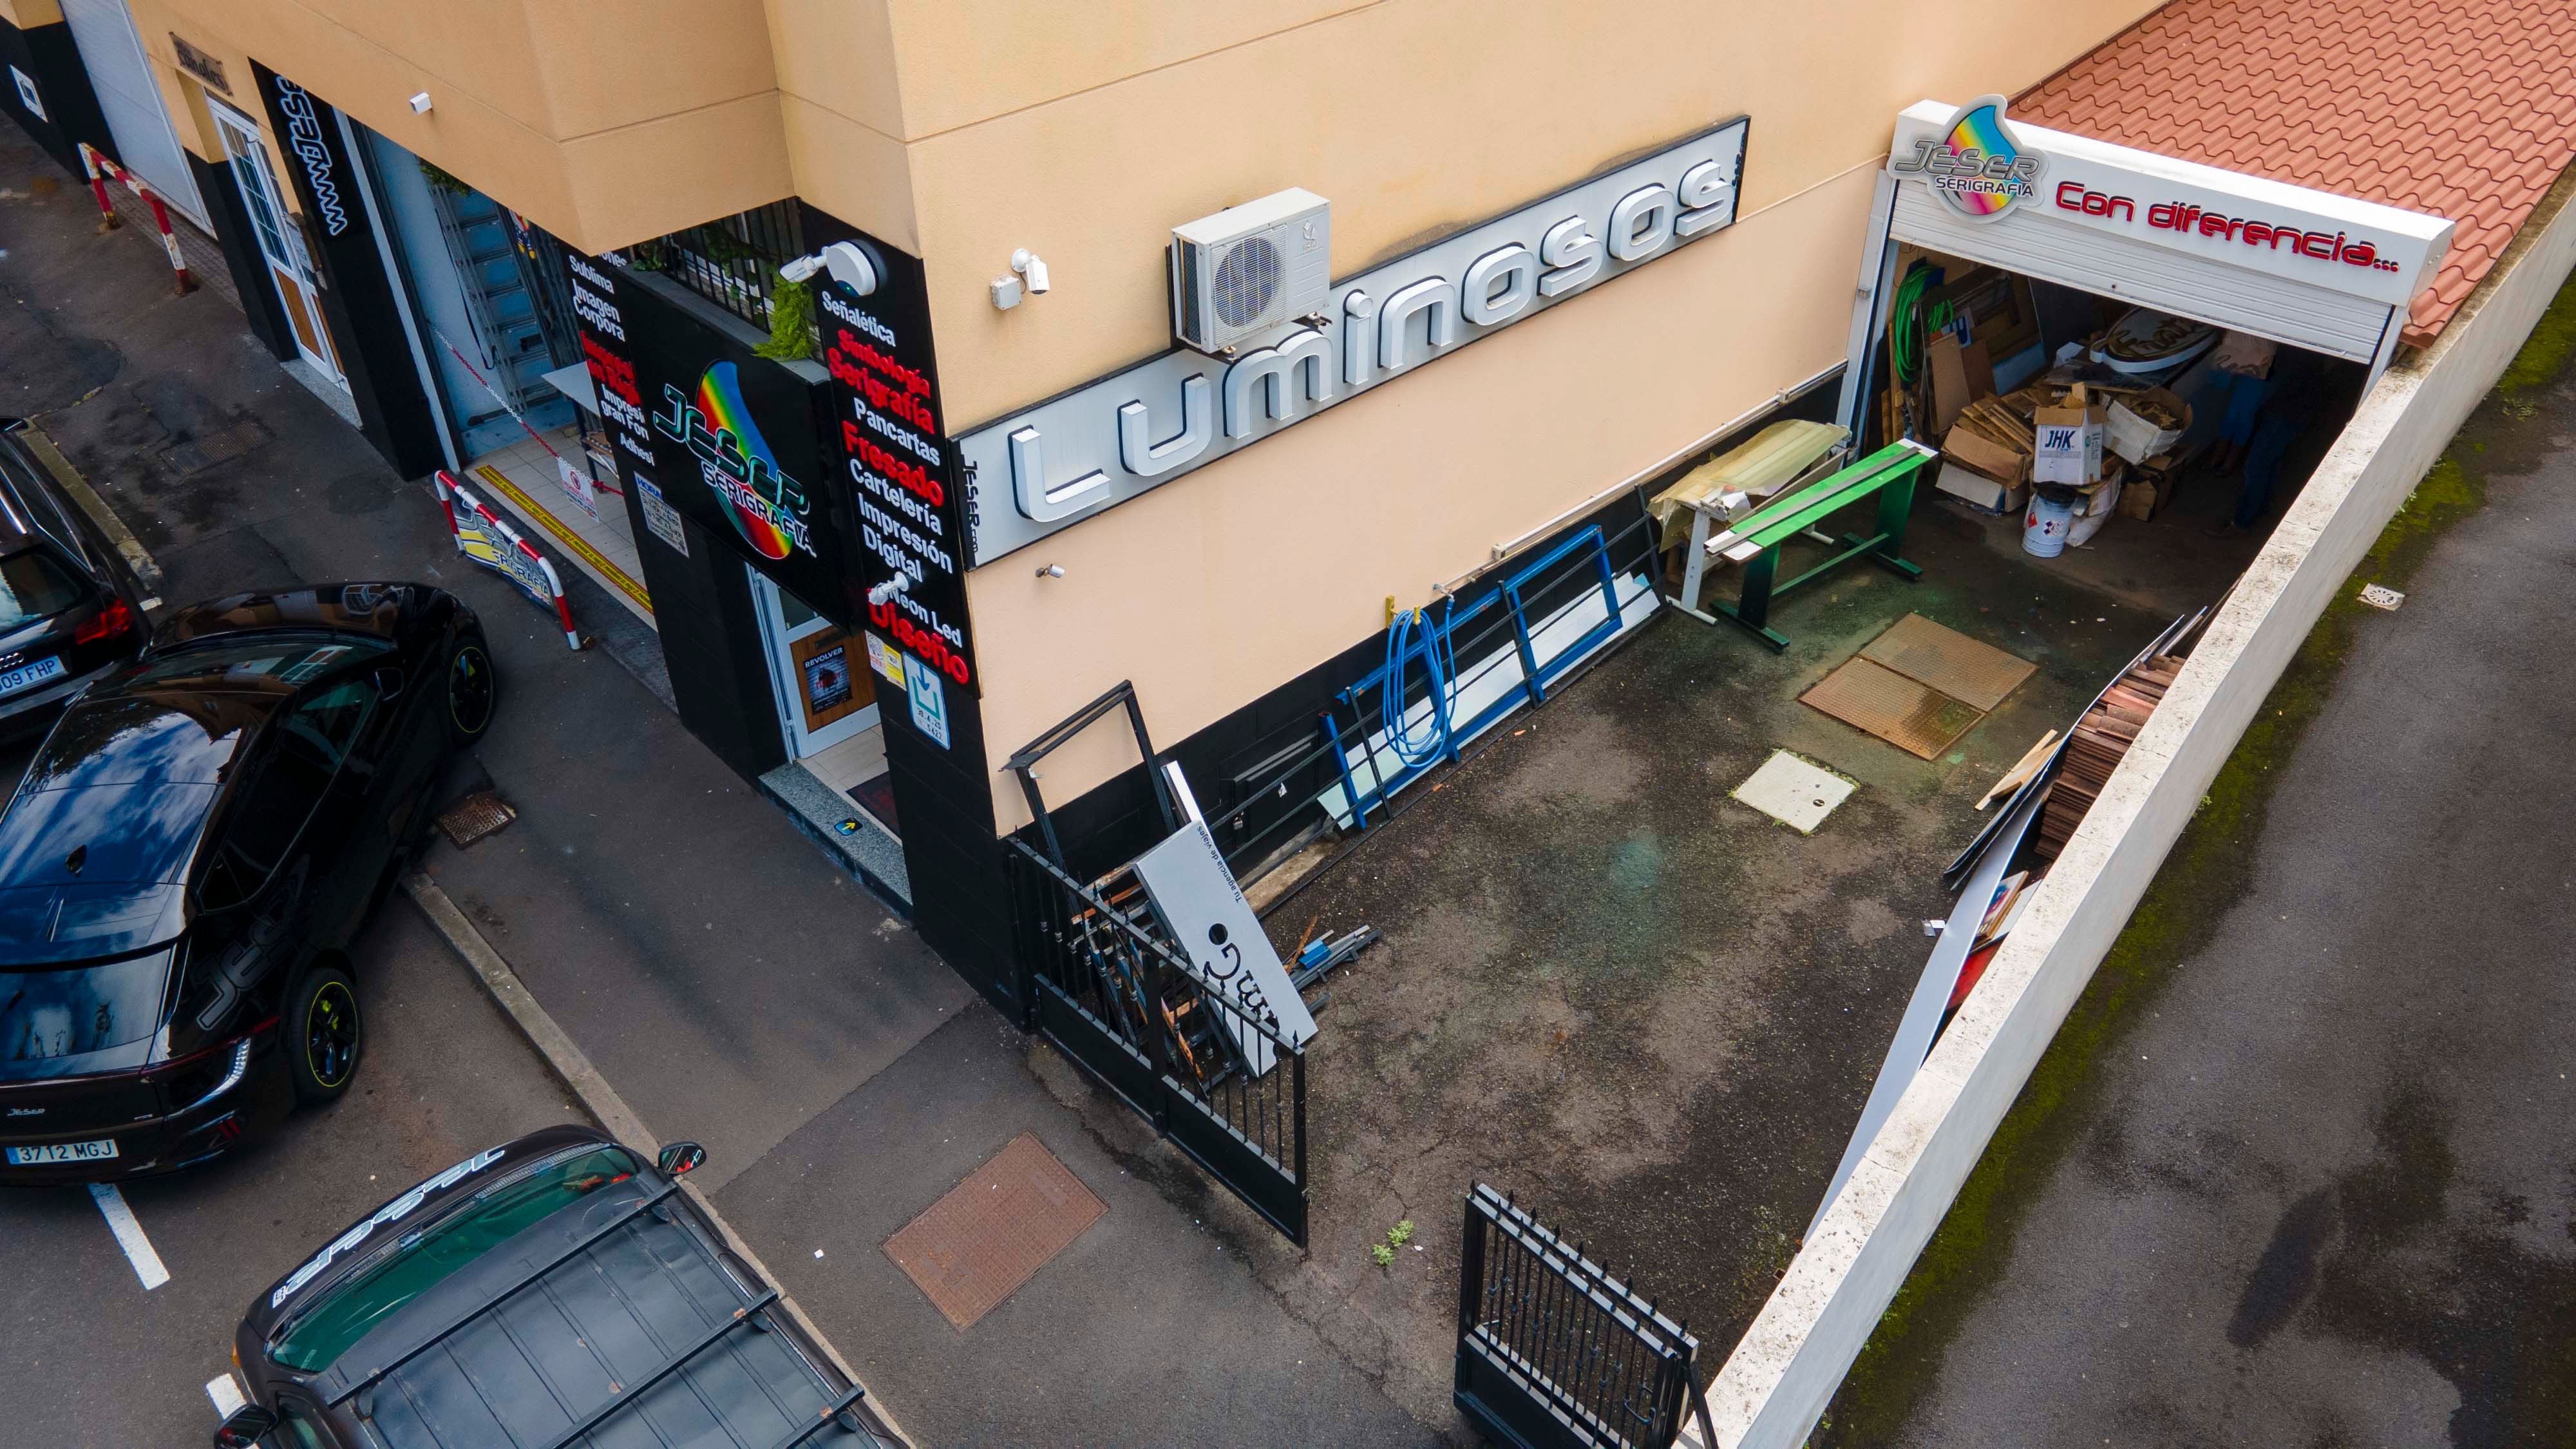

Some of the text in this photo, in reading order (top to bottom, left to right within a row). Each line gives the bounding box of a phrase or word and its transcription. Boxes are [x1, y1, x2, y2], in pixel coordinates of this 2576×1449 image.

[1893, 139, 2040, 183] JESER
[1935, 175, 2034, 198] SERIGRAFIA
[2055, 180, 2400, 274] Con diferencia...
[572, 278, 621, 323] Imagen
[822, 290, 896, 348] Señalética
[838, 327, 931, 401] Simbología
[1011, 158, 1734, 523] Luminosos
[601, 383, 645, 424] Impresi
[827, 346, 935, 435] Serigrafía
[652, 383, 811, 516] JESER
[854, 396, 940, 468] Pancartas
[2045, 430, 2076, 449] JHK
[842, 420, 944, 507] Fresado
[701, 460, 817, 558] SERIGRAFIA
[849, 457, 943, 536] Cartelería
[858, 493, 953, 575] Impresión
[864, 524, 923, 582] Digital
[804, 647, 844, 668] REVOLVER
[866, 587, 969, 685] Diseño
[931, 611, 963, 649] Led
[0, 660, 55, 692] 09 FHP
[1197, 826, 1212, 849] viajes
[1211, 849, 1219, 860] de
[6, 1107, 46, 1117] JESER
[20, 1141, 112, 1161] 3712 MGJ
